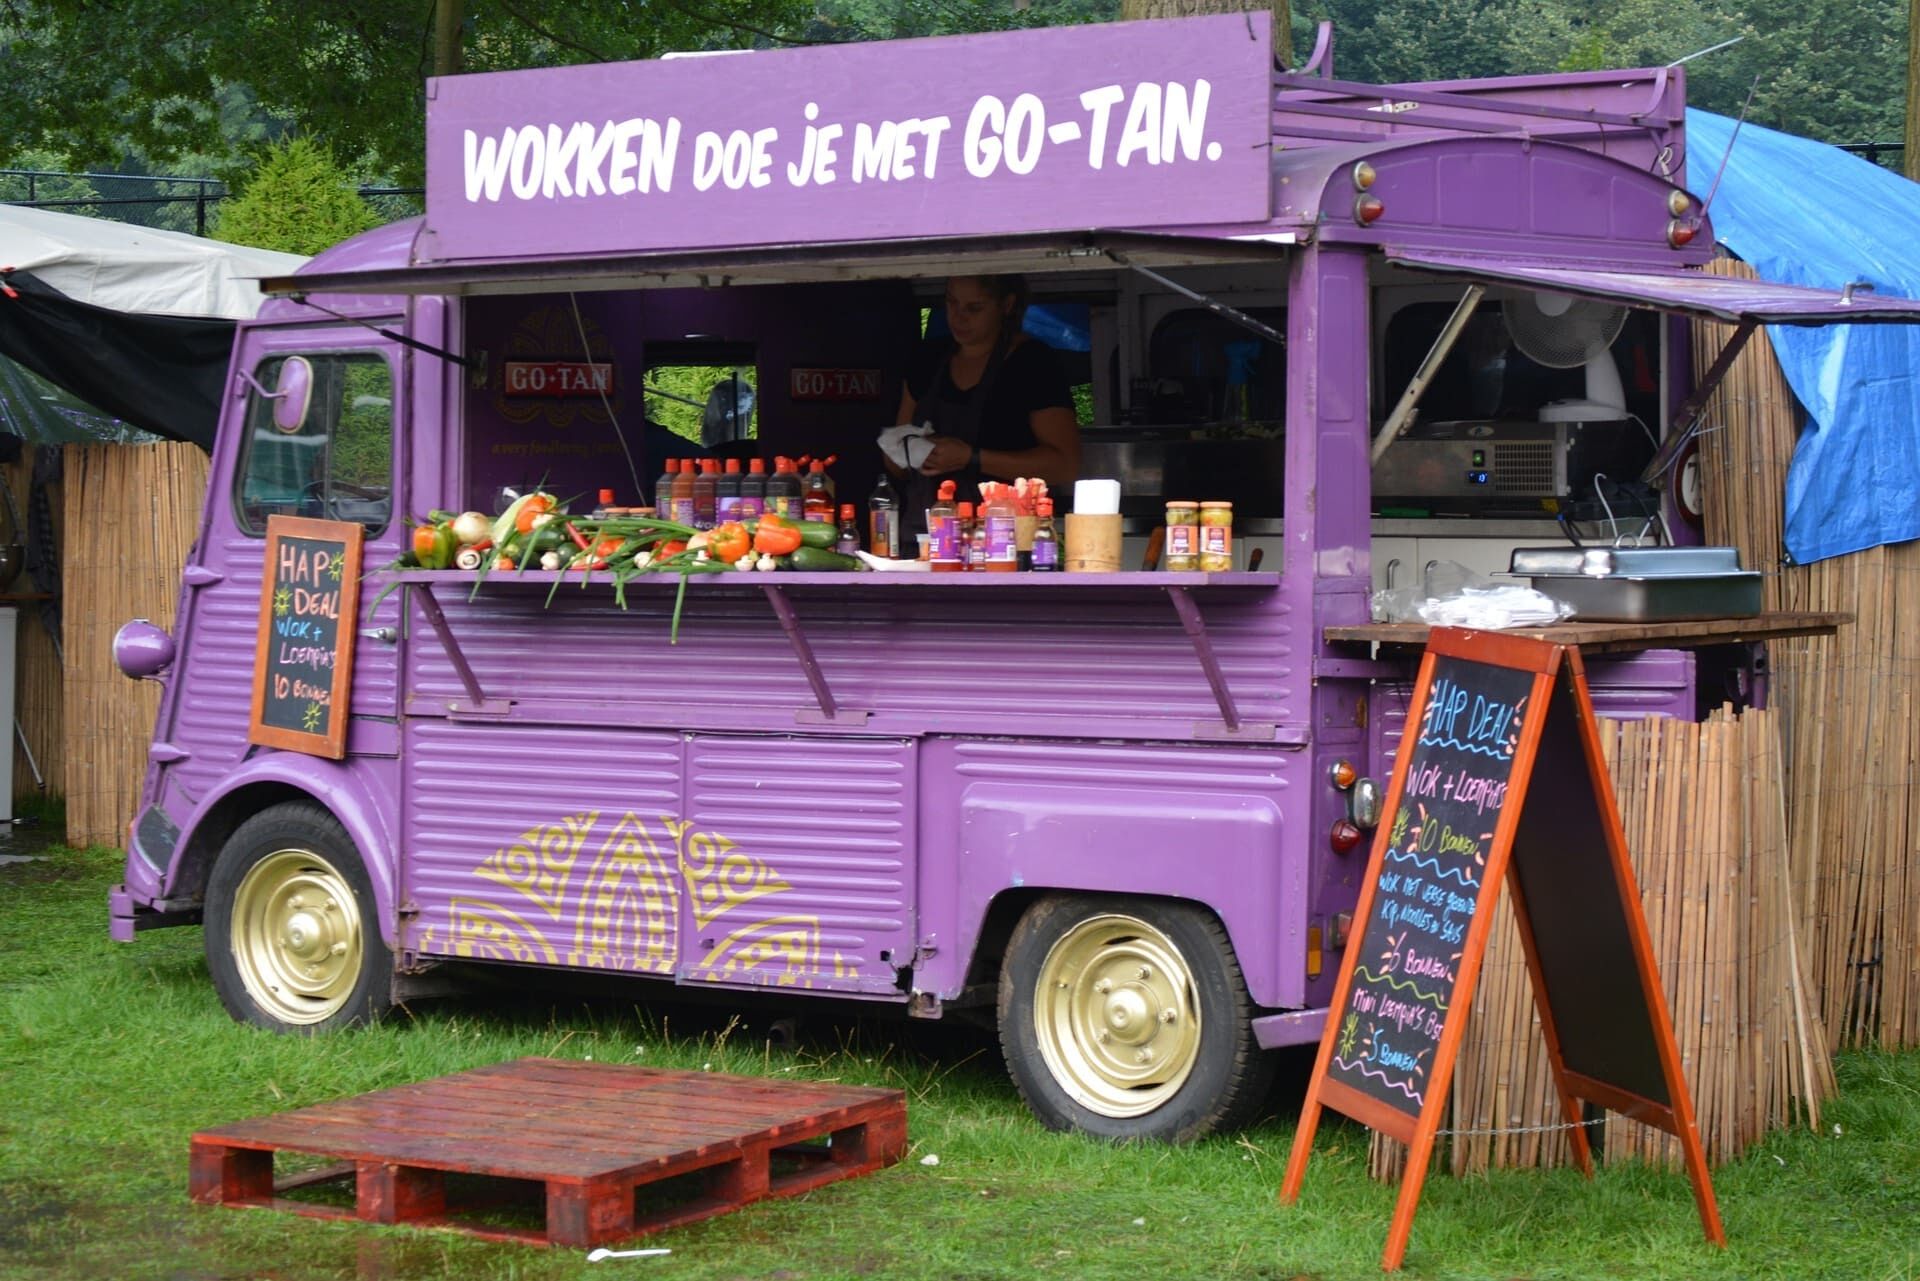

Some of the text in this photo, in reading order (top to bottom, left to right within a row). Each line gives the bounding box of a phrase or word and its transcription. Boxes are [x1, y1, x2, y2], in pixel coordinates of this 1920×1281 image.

[465, 117, 681, 202] WOKKEN
[693, 127, 778, 191] DOE
[852, 116, 951, 183] MET
[964, 78, 1223, 178] GO-TAN.
[280, 544, 330, 588] HAP
[294, 588, 339, 619] DEAL
[276, 616, 311, 639] WOK
[274, 673, 290, 699] 10
[1427, 679, 1514, 744] HAP DEAL
[1406, 760, 1442, 798] WOK
[1418, 813, 1438, 852] 10
[1379, 871, 1401, 893] WOK
[1402, 877, 1423, 896] MET
[1389, 931, 1408, 972] 6
[1366, 1028, 1385, 1062] 5
